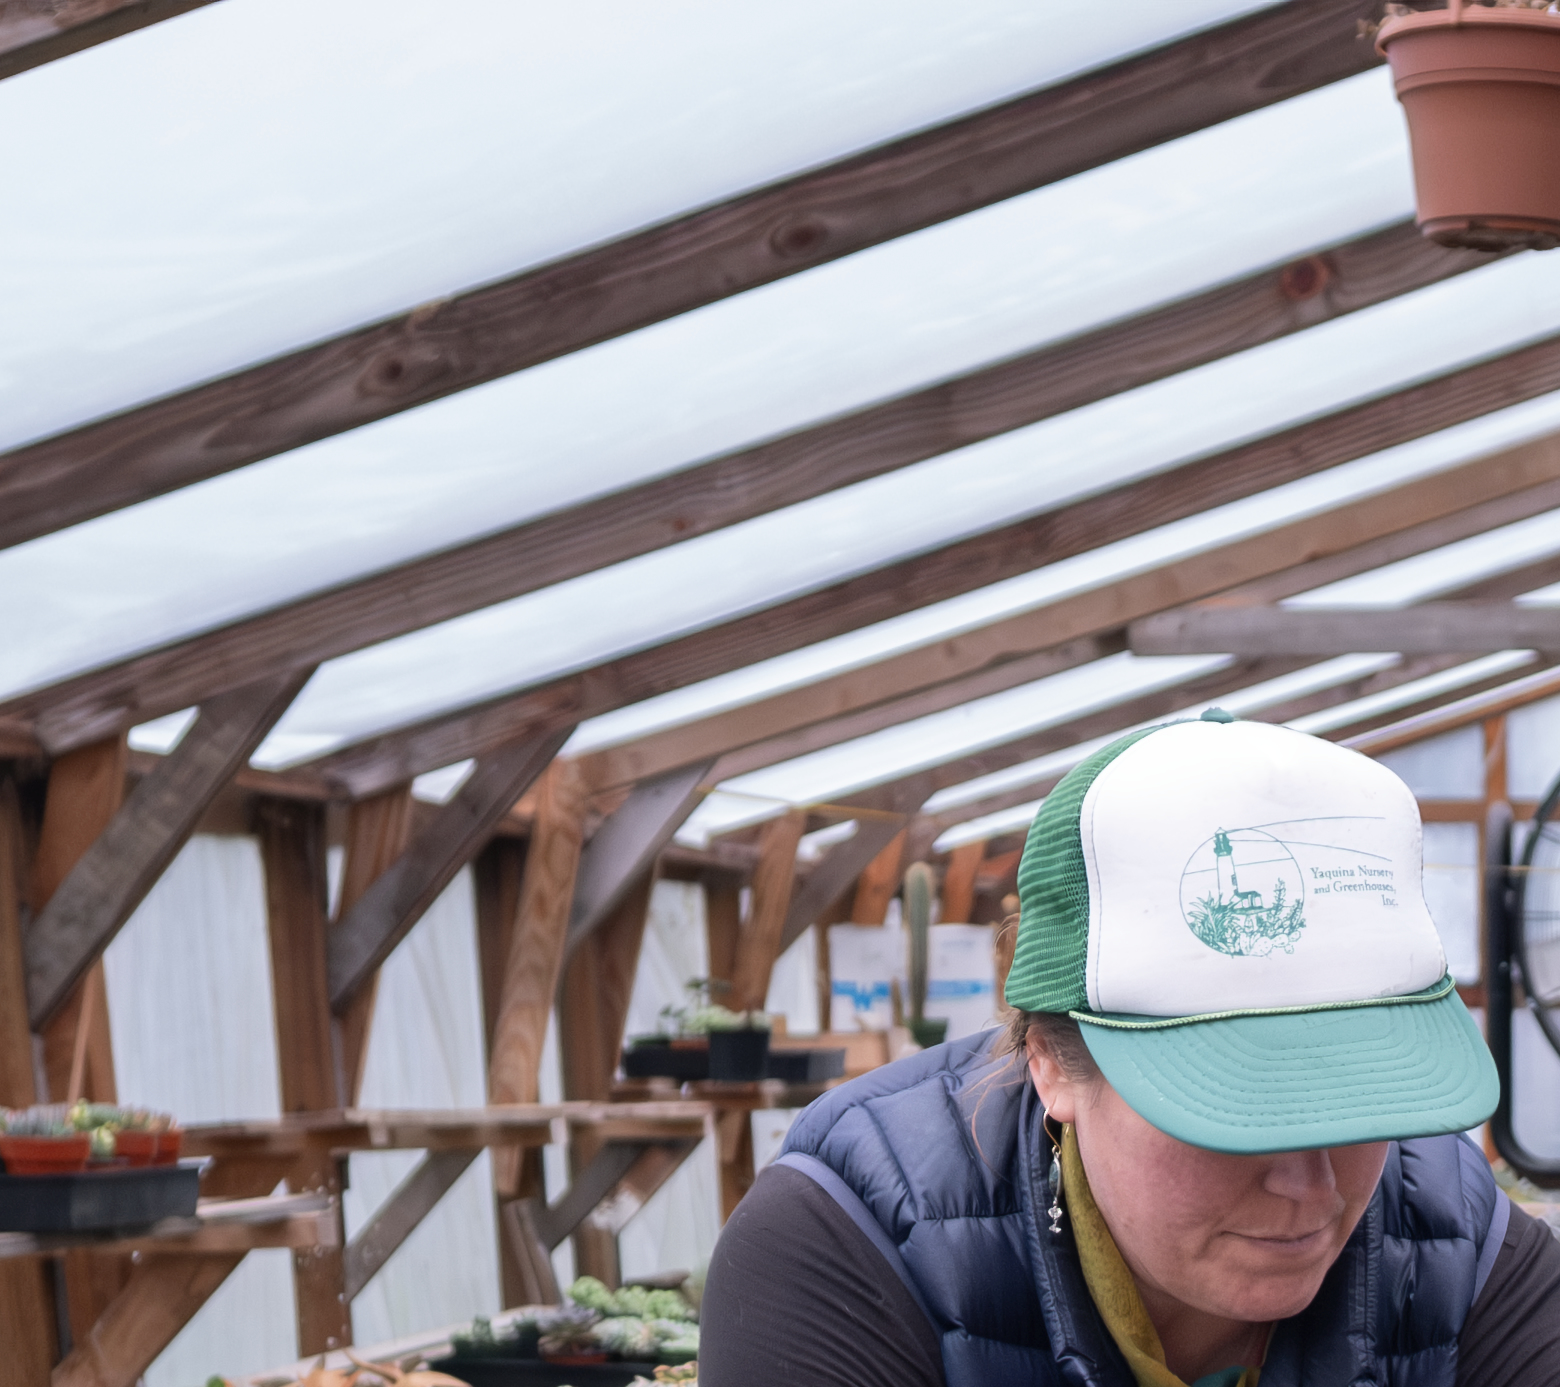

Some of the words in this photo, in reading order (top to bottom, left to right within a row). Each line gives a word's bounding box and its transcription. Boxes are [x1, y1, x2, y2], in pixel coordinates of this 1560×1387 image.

[1310, 866, 1355, 880] Yaquina
[1357, 864, 1394, 880] Nursery
[1314, 884, 1330, 894] and
[1381, 894, 1398, 906] Inc.
